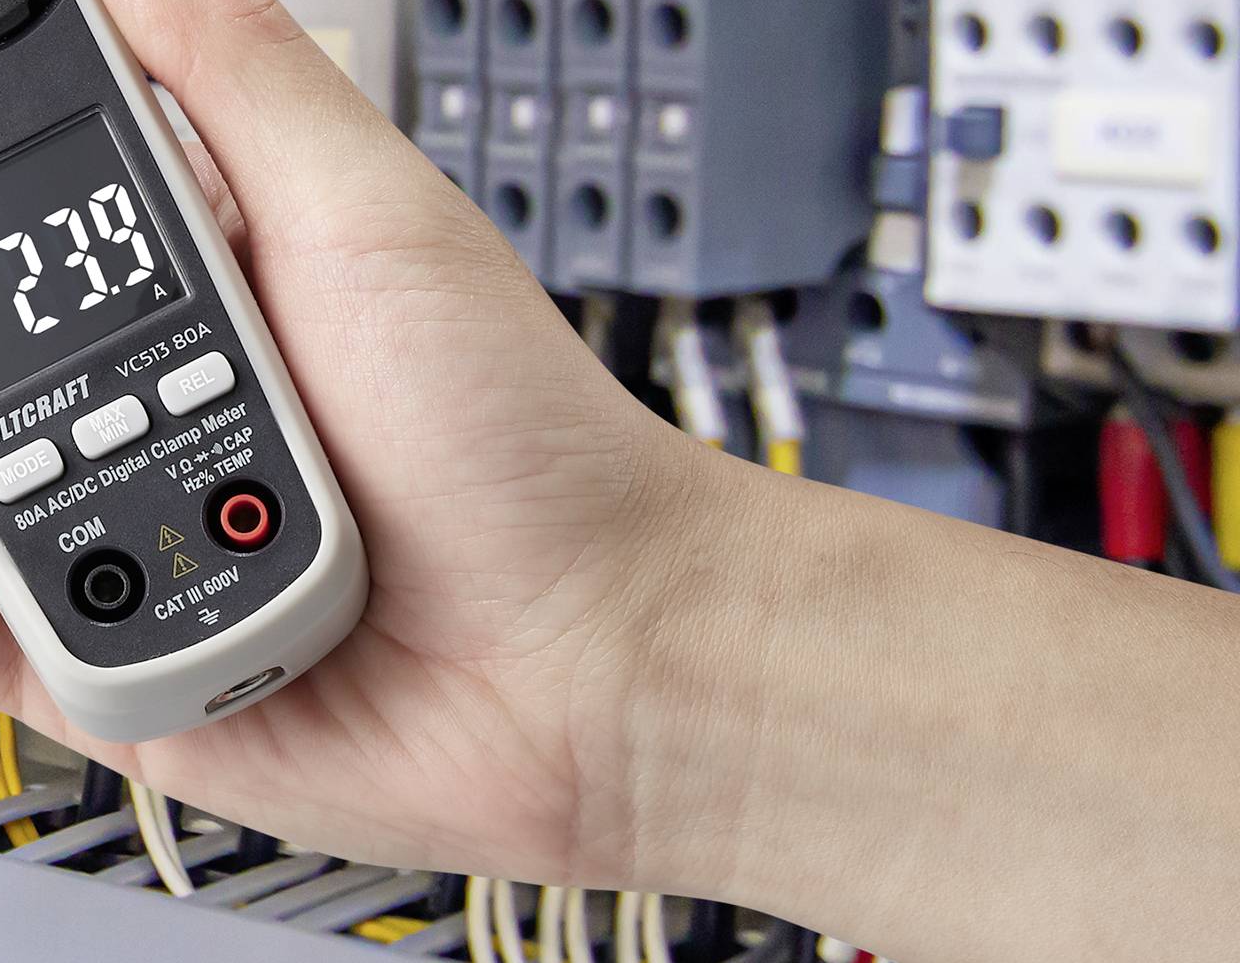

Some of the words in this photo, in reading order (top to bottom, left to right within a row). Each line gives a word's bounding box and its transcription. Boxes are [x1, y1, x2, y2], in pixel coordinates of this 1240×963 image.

[153, 283, 168, 300] A
[115, 343, 170, 378] VC513
[171, 321, 212, 350] 80A
[178, 369, 215, 396] REL
[89, 405, 126, 432] MAX
[98, 422, 130, 445] MIN
[223, 426, 253, 451] CAP
[0, 450, 51, 486] MODE
[14, 507, 48, 531] 80A
[47, 476, 99, 516] AC/DC
[98, 450, 151, 488] Digital
[150, 427, 202, 459] Clamp
[200, 402, 247, 434] Meter
[181, 468, 215, 494] Hz%
[213, 448, 253, 477] TEMP
[58, 516, 107, 553] COM
[154, 590, 186, 621] CAT
[186, 584, 205, 604] III
[203, 565, 241, 594] 600V
